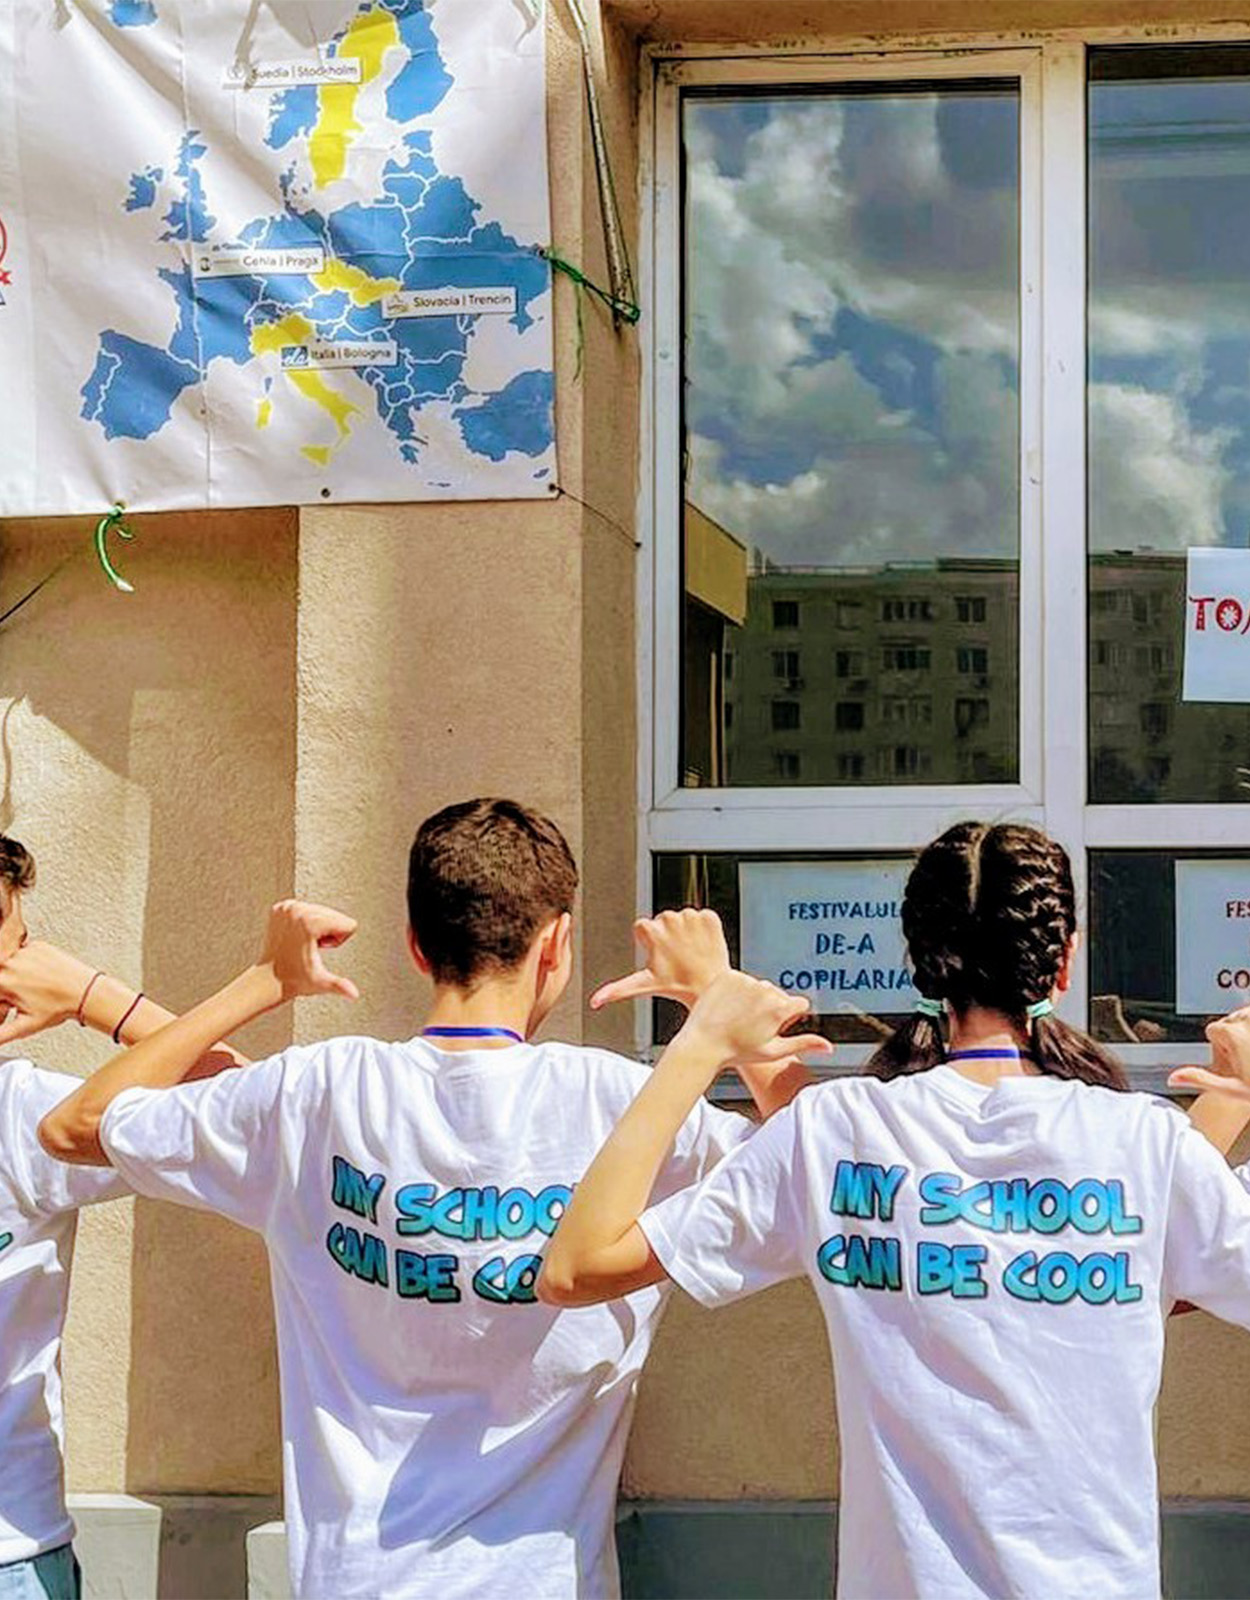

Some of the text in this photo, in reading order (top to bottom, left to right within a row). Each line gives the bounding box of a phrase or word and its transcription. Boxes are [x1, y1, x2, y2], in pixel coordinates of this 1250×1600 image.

[243, 255, 319, 268] Cehia Praga
[413, 294, 512, 308] Slovacia Trencin
[311, 349, 336, 359] Italia
[343, 348, 391, 360] Bologna
[789, 902, 900, 920] FESTIVALUL
[816, 933, 875, 955] DE-A
[779, 969, 914, 991] COPILARIA
[332, 1155, 577, 1241] MY SCHOO
[830, 1160, 1142, 1235] MY SCHOOL
[327, 1222, 543, 1303] CAN BE CO
[817, 1234, 1142, 1305] CAN BE COOL
